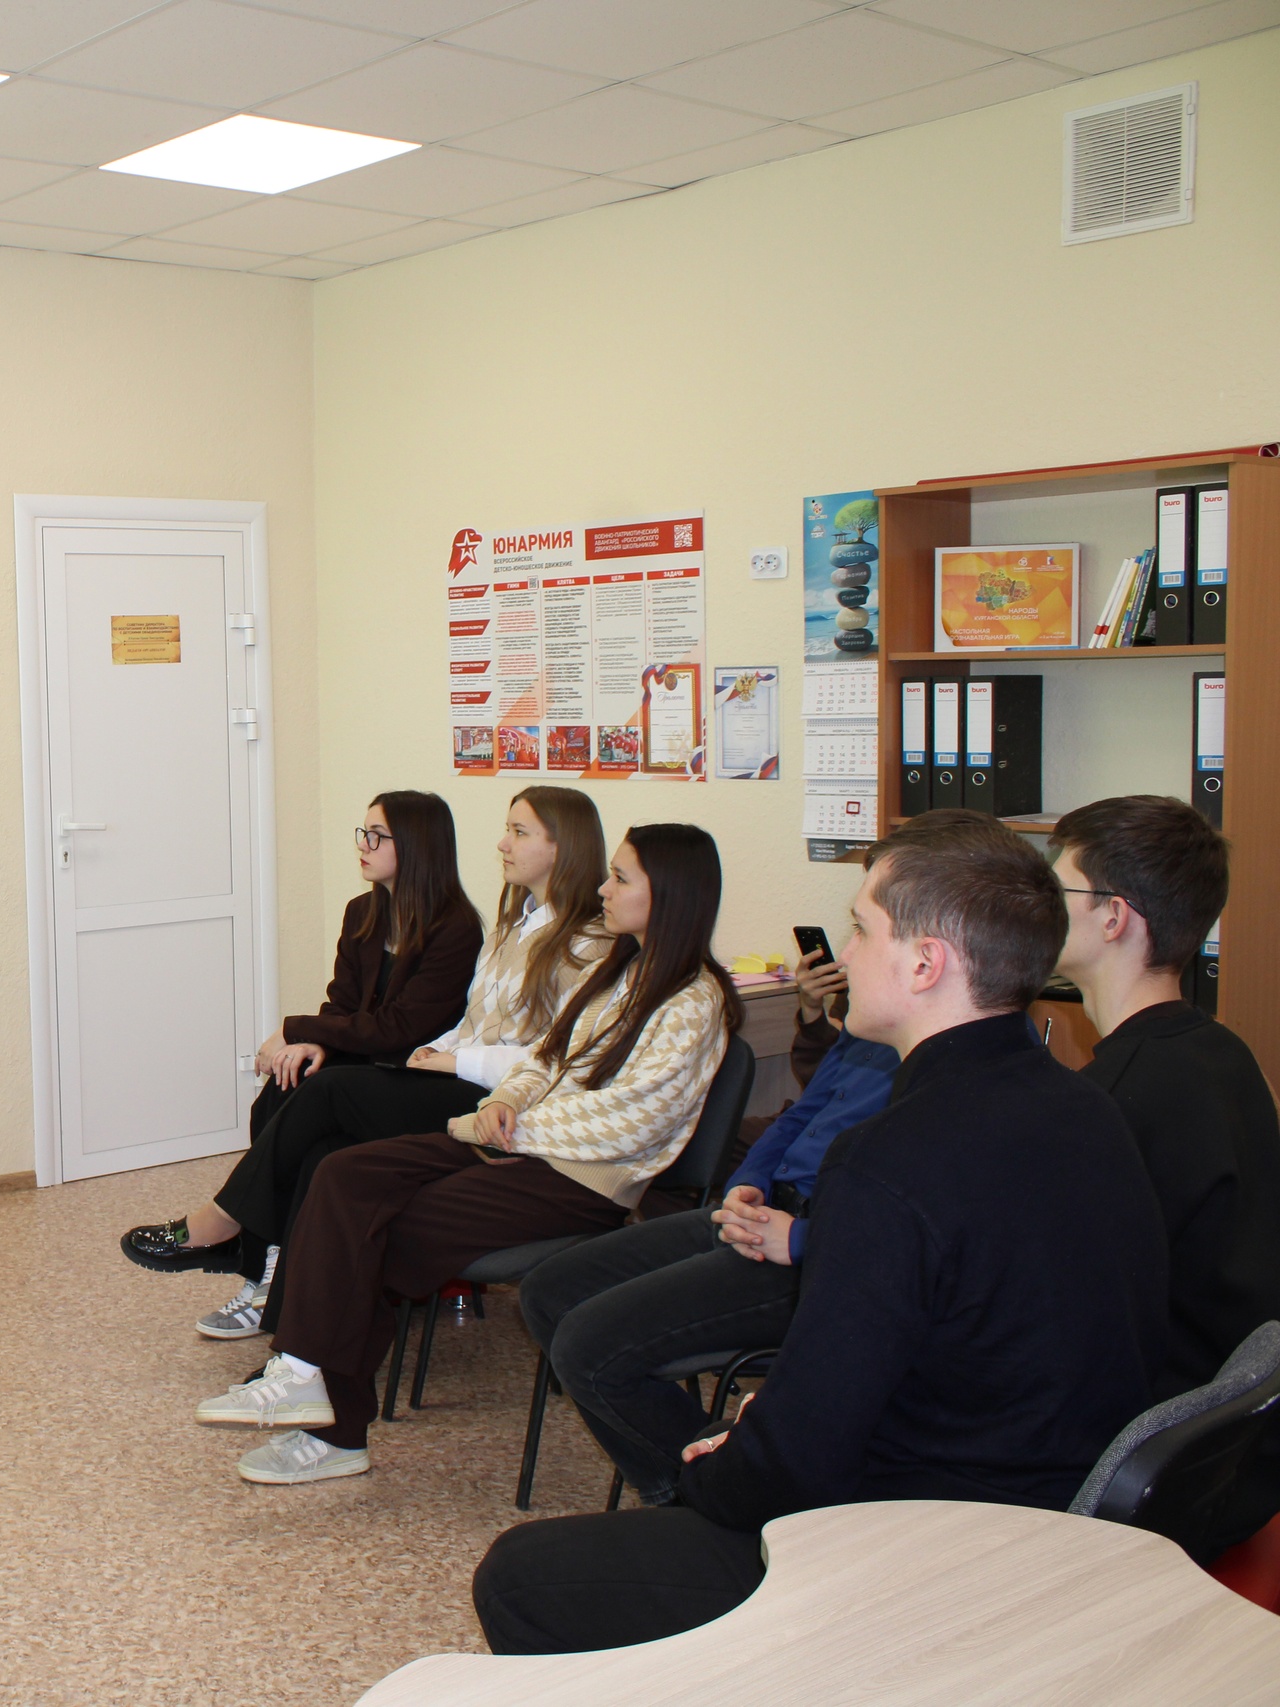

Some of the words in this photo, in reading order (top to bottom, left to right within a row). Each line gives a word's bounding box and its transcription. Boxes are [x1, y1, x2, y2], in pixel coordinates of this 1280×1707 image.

[594, 527, 660, 540] ВОЕННО-ПАТРИОТИЧЕСКИЙ
[493, 530, 573, 555] ЮНАРМИЯ
[594, 538, 620, 546] АВАНГАРД
[594, 544, 622, 553] ДВИЖЕНИЯ
[836, 550, 870, 559] Счастье
[493, 555, 533, 565] ВСЕРОССИЙСКОЕ
[493, 563, 544, 574] ДЕТСКО-ЮНОШЕСКОЕ
[544, 560, 573, 570] ДВИЖЕНИЕ
[663, 570, 684, 578] ЗАДАЧИ
